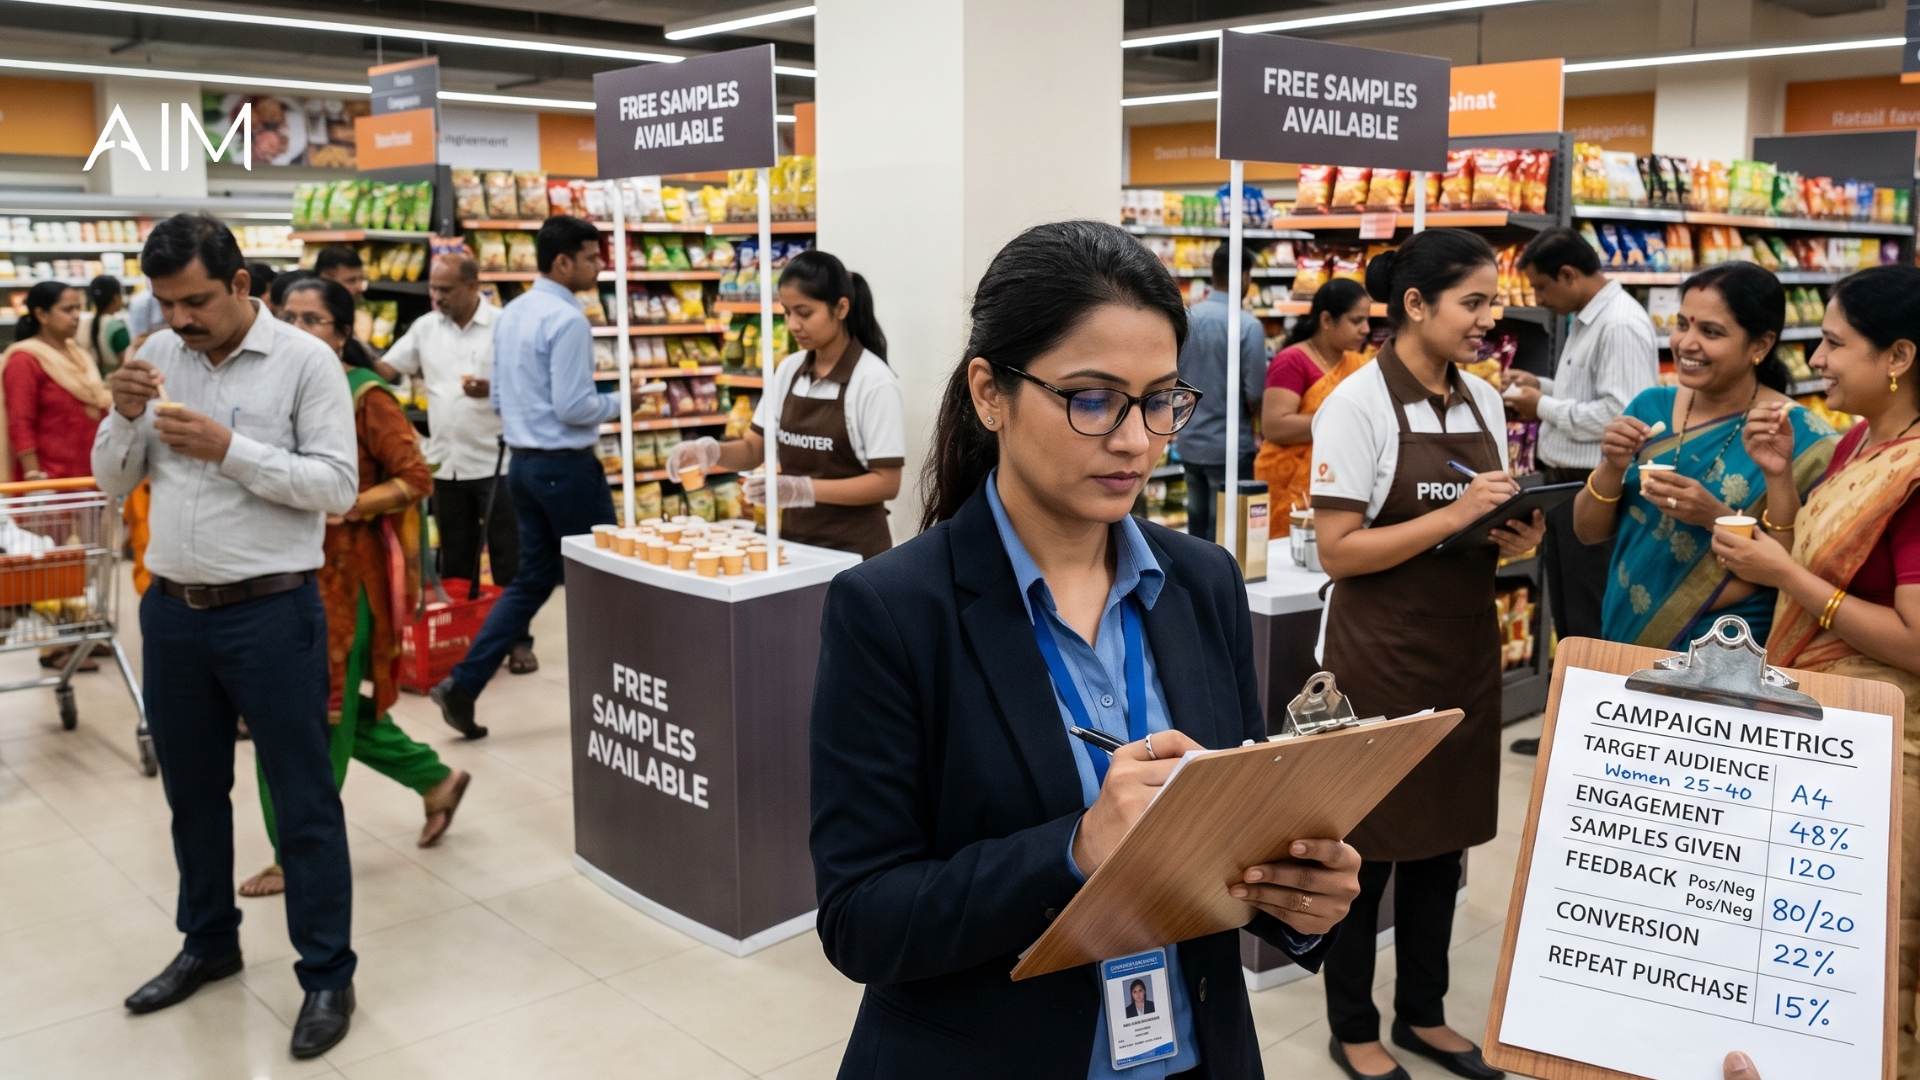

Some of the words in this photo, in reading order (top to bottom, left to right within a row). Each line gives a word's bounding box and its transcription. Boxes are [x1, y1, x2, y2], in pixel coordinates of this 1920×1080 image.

[619, 92, 658, 122] FREE
[660, 80, 740, 117] SAMPLES
[1263, 67, 1319, 99] FREE
[1323, 74, 1418, 110] SAMPLES
[634, 116, 725, 151] AVAILABLE
[1282, 106, 1399, 141] AVAILABLE
[613, 663, 669, 713] FREE
[592, 693, 697, 763] SAMPLES
[1595, 700, 1732, 741] CAMPAIGN
[1739, 723, 1855, 760] METRICS
[587, 730, 710, 810] AVAILABLE
[1583, 734, 1661, 762] TARGET
[1664, 749, 1770, 782] AUDIENCE
[1604, 762, 1671, 788] Women
[1683, 775, 1753, 801] 25-40
[1575, 784, 1725, 827] ENGAGEMENT
[1569, 815, 1668, 849] SAMPLES
[1674, 834, 1742, 863] GIVEN
[1789, 820, 1850, 852] 48%
[1565, 849, 1678, 888] FEEDBACK
[1688, 872, 1757, 902] Pos/Neg
[1789, 856, 1836, 881] 120
[1556, 901, 1700, 947] CONVERSION
[1685, 892, 1754, 923] Pos/Neg
[1772, 897, 1855, 935] 80/20
[1548, 945, 1629, 978] REPEAT
[1632, 962, 1749, 1004] PURCHASE
[1773, 942, 1836, 978] 22%
[1774, 992, 1831, 1028] 15%
